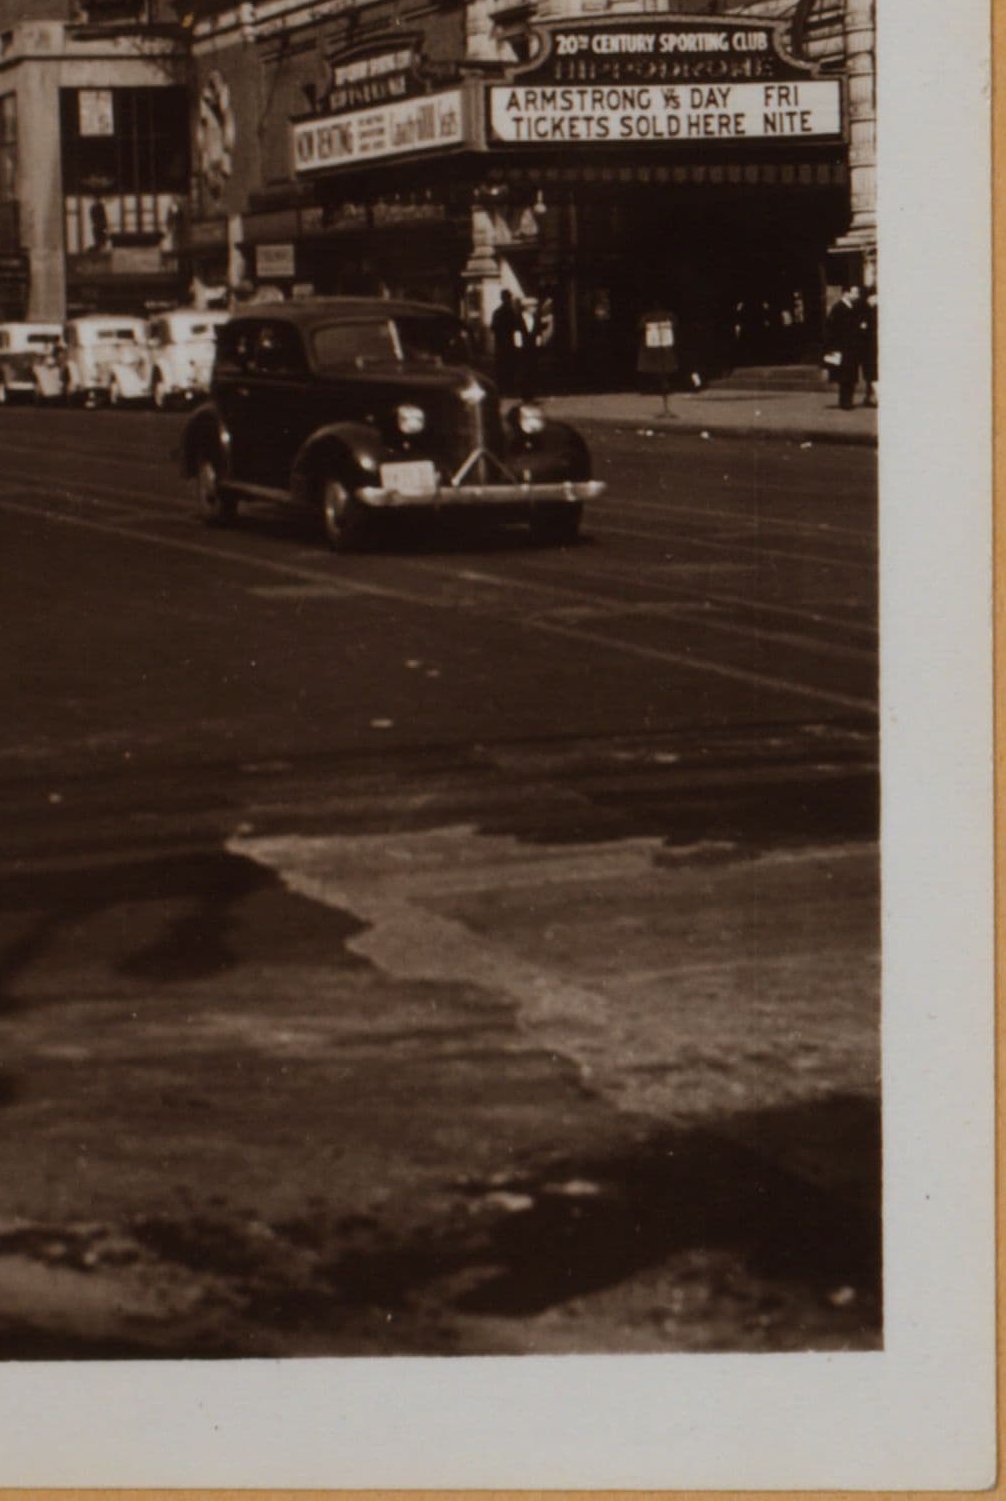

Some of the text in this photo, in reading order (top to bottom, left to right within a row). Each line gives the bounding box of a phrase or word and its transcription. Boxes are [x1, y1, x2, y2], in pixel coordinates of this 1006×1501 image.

[592, 33, 656, 54] CENTURY
[659, 31, 729, 53] SPORTING
[732, 31, 768, 51] CLUB
[506, 89, 651, 112] ARMSTRONG
[690, 87, 732, 109] DAY
[763, 85, 799, 107] FRI
[512, 110, 813, 138] TICKETS SOLD HERE NITE
